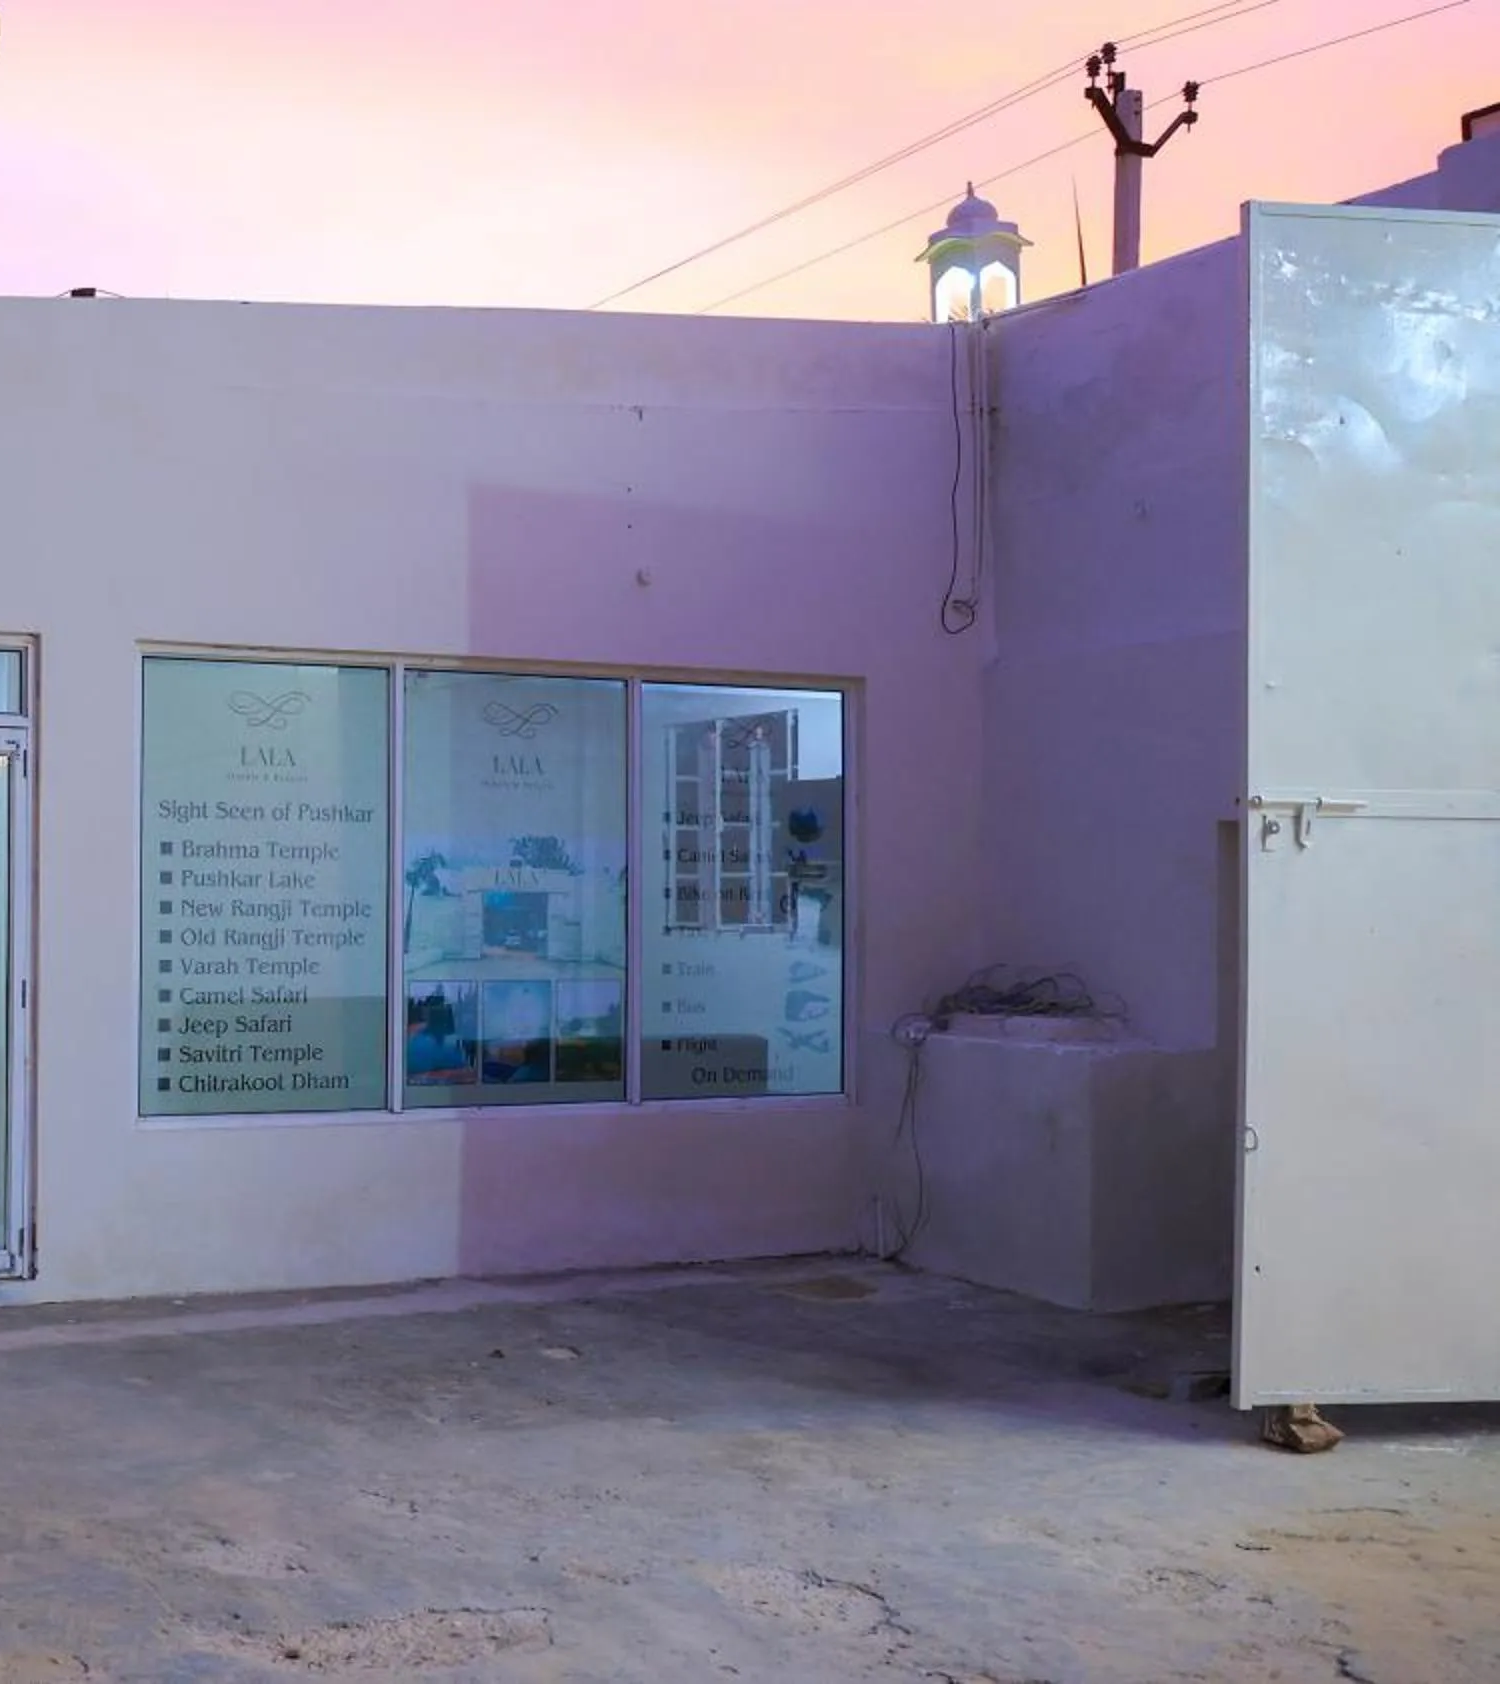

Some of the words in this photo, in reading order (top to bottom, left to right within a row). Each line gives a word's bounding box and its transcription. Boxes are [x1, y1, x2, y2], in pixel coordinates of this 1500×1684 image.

[240, 745, 297, 767] LALA
[159, 800, 208, 823] Sight
[215, 801, 264, 820] Seen
[271, 803, 291, 821] of
[298, 804, 374, 823] Pushkar
[181, 840, 259, 859] Brahma
[264, 841, 339, 864] Temple
[181, 869, 262, 888] Pushkar
[269, 870, 316, 889] Lake
[181, 899, 223, 917] New
[231, 899, 292, 921] Rangji
[301, 900, 372, 922] Temple
[180, 928, 215, 946] Old
[223, 928, 285, 950] Rangji
[291, 928, 365, 950] Temple
[180, 959, 238, 975] Varah
[245, 958, 320, 979] Temple
[180, 987, 244, 1005] Camel
[251, 986, 308, 1004] Safari
[178, 1017, 229, 1038] Jeep
[235, 1015, 292, 1033] Safari
[179, 1045, 242, 1063] Savitri
[249, 1043, 324, 1065] Temple
[179, 1073, 284, 1092] Chitrakoot
[291, 1071, 349, 1089] Dham
[691, 1066, 717, 1084] On
[723, 1063, 794, 1082] Demand
